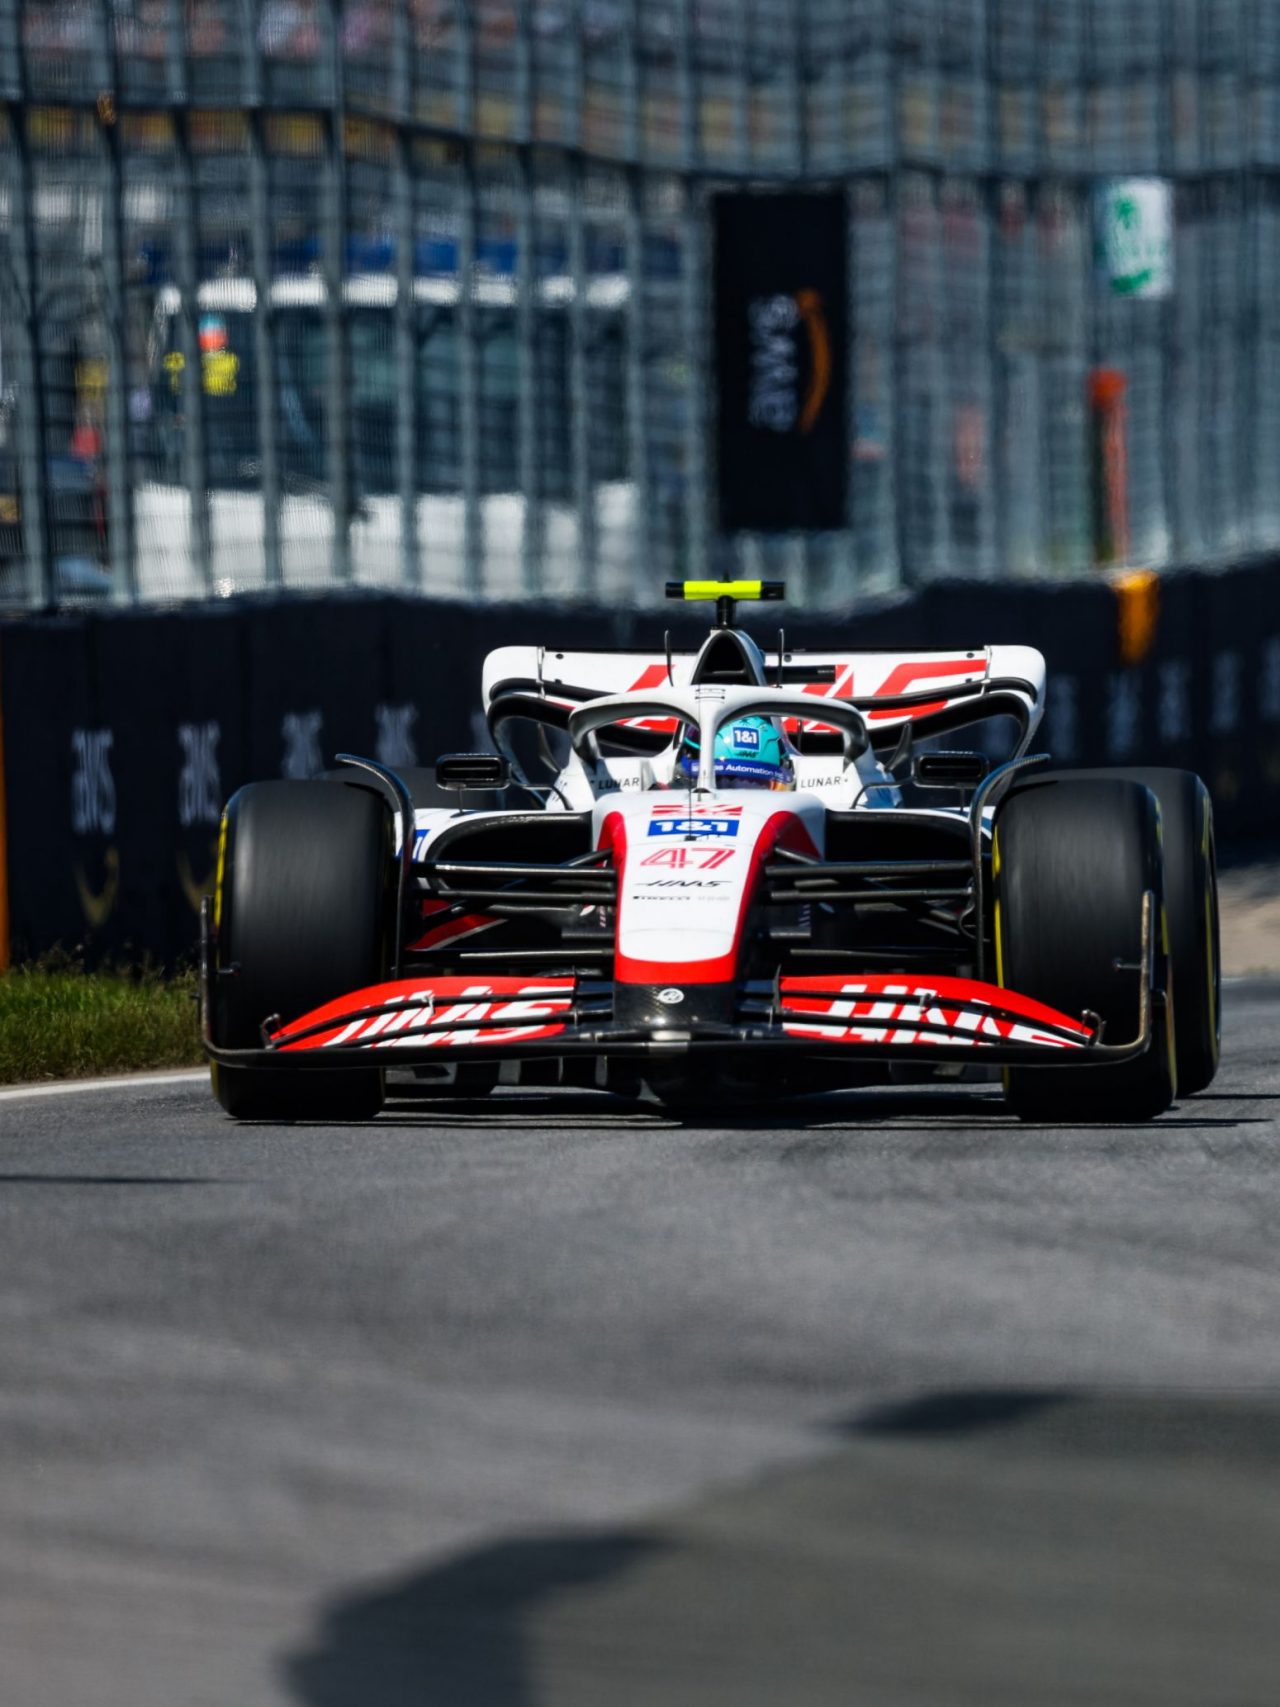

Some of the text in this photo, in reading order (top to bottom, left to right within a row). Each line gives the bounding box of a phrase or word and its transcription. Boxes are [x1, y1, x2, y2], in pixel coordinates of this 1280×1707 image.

[734, 730, 757, 744] 1&1
[725, 763, 774, 776] Automation
[598, 777, 640, 790] LUNAR
[800, 776, 842, 788] LUNAR
[655, 820, 729, 833] 1&1
[639, 847, 736, 869] 47
